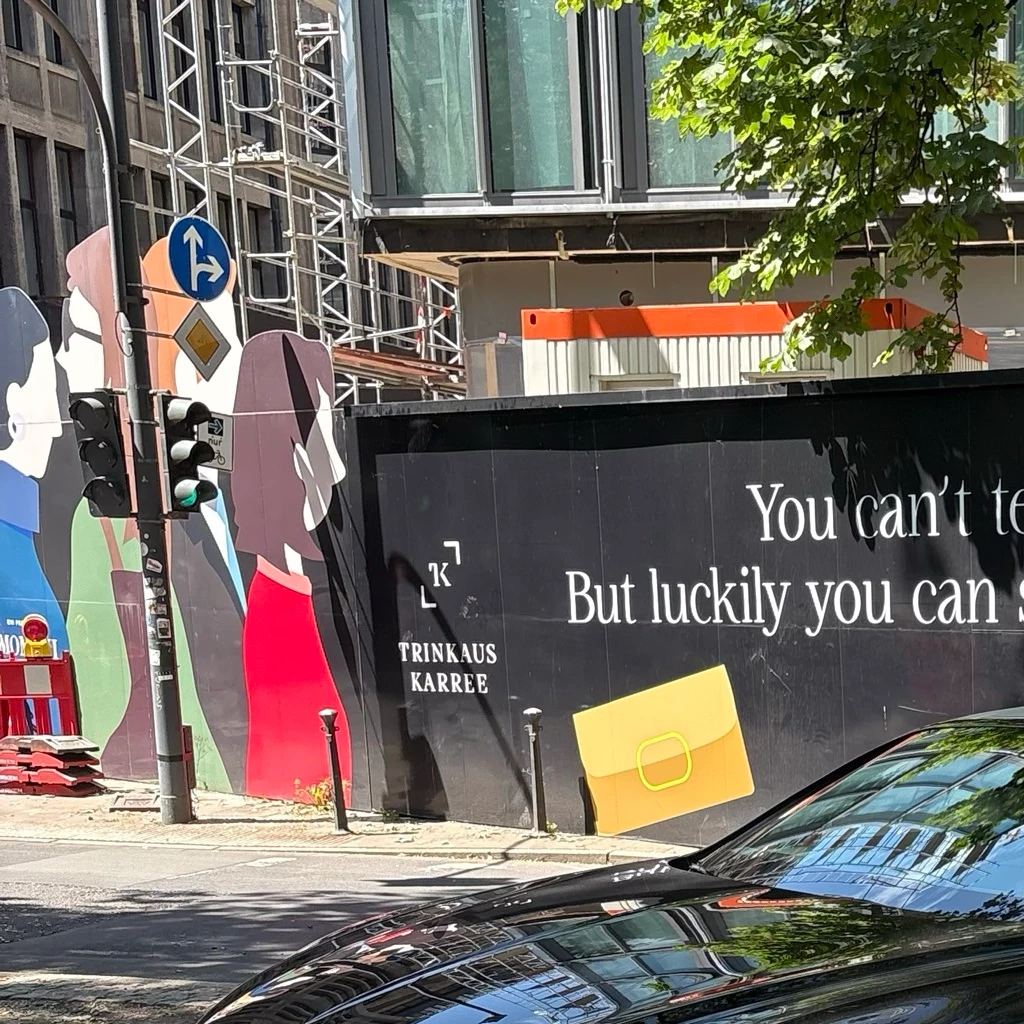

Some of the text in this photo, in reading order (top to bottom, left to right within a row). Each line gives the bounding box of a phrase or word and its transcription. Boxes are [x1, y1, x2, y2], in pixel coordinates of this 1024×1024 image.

[746, 483, 838, 541] You
[856, 475, 972, 539] can't
[565, 570, 637, 625] But
[649, 566, 791, 637] luckily
[805, 580, 895, 637] you
[912, 578, 999, 625] can
[398, 642, 497, 664] TRINKAUS
[411, 671, 488, 694] KARREE
